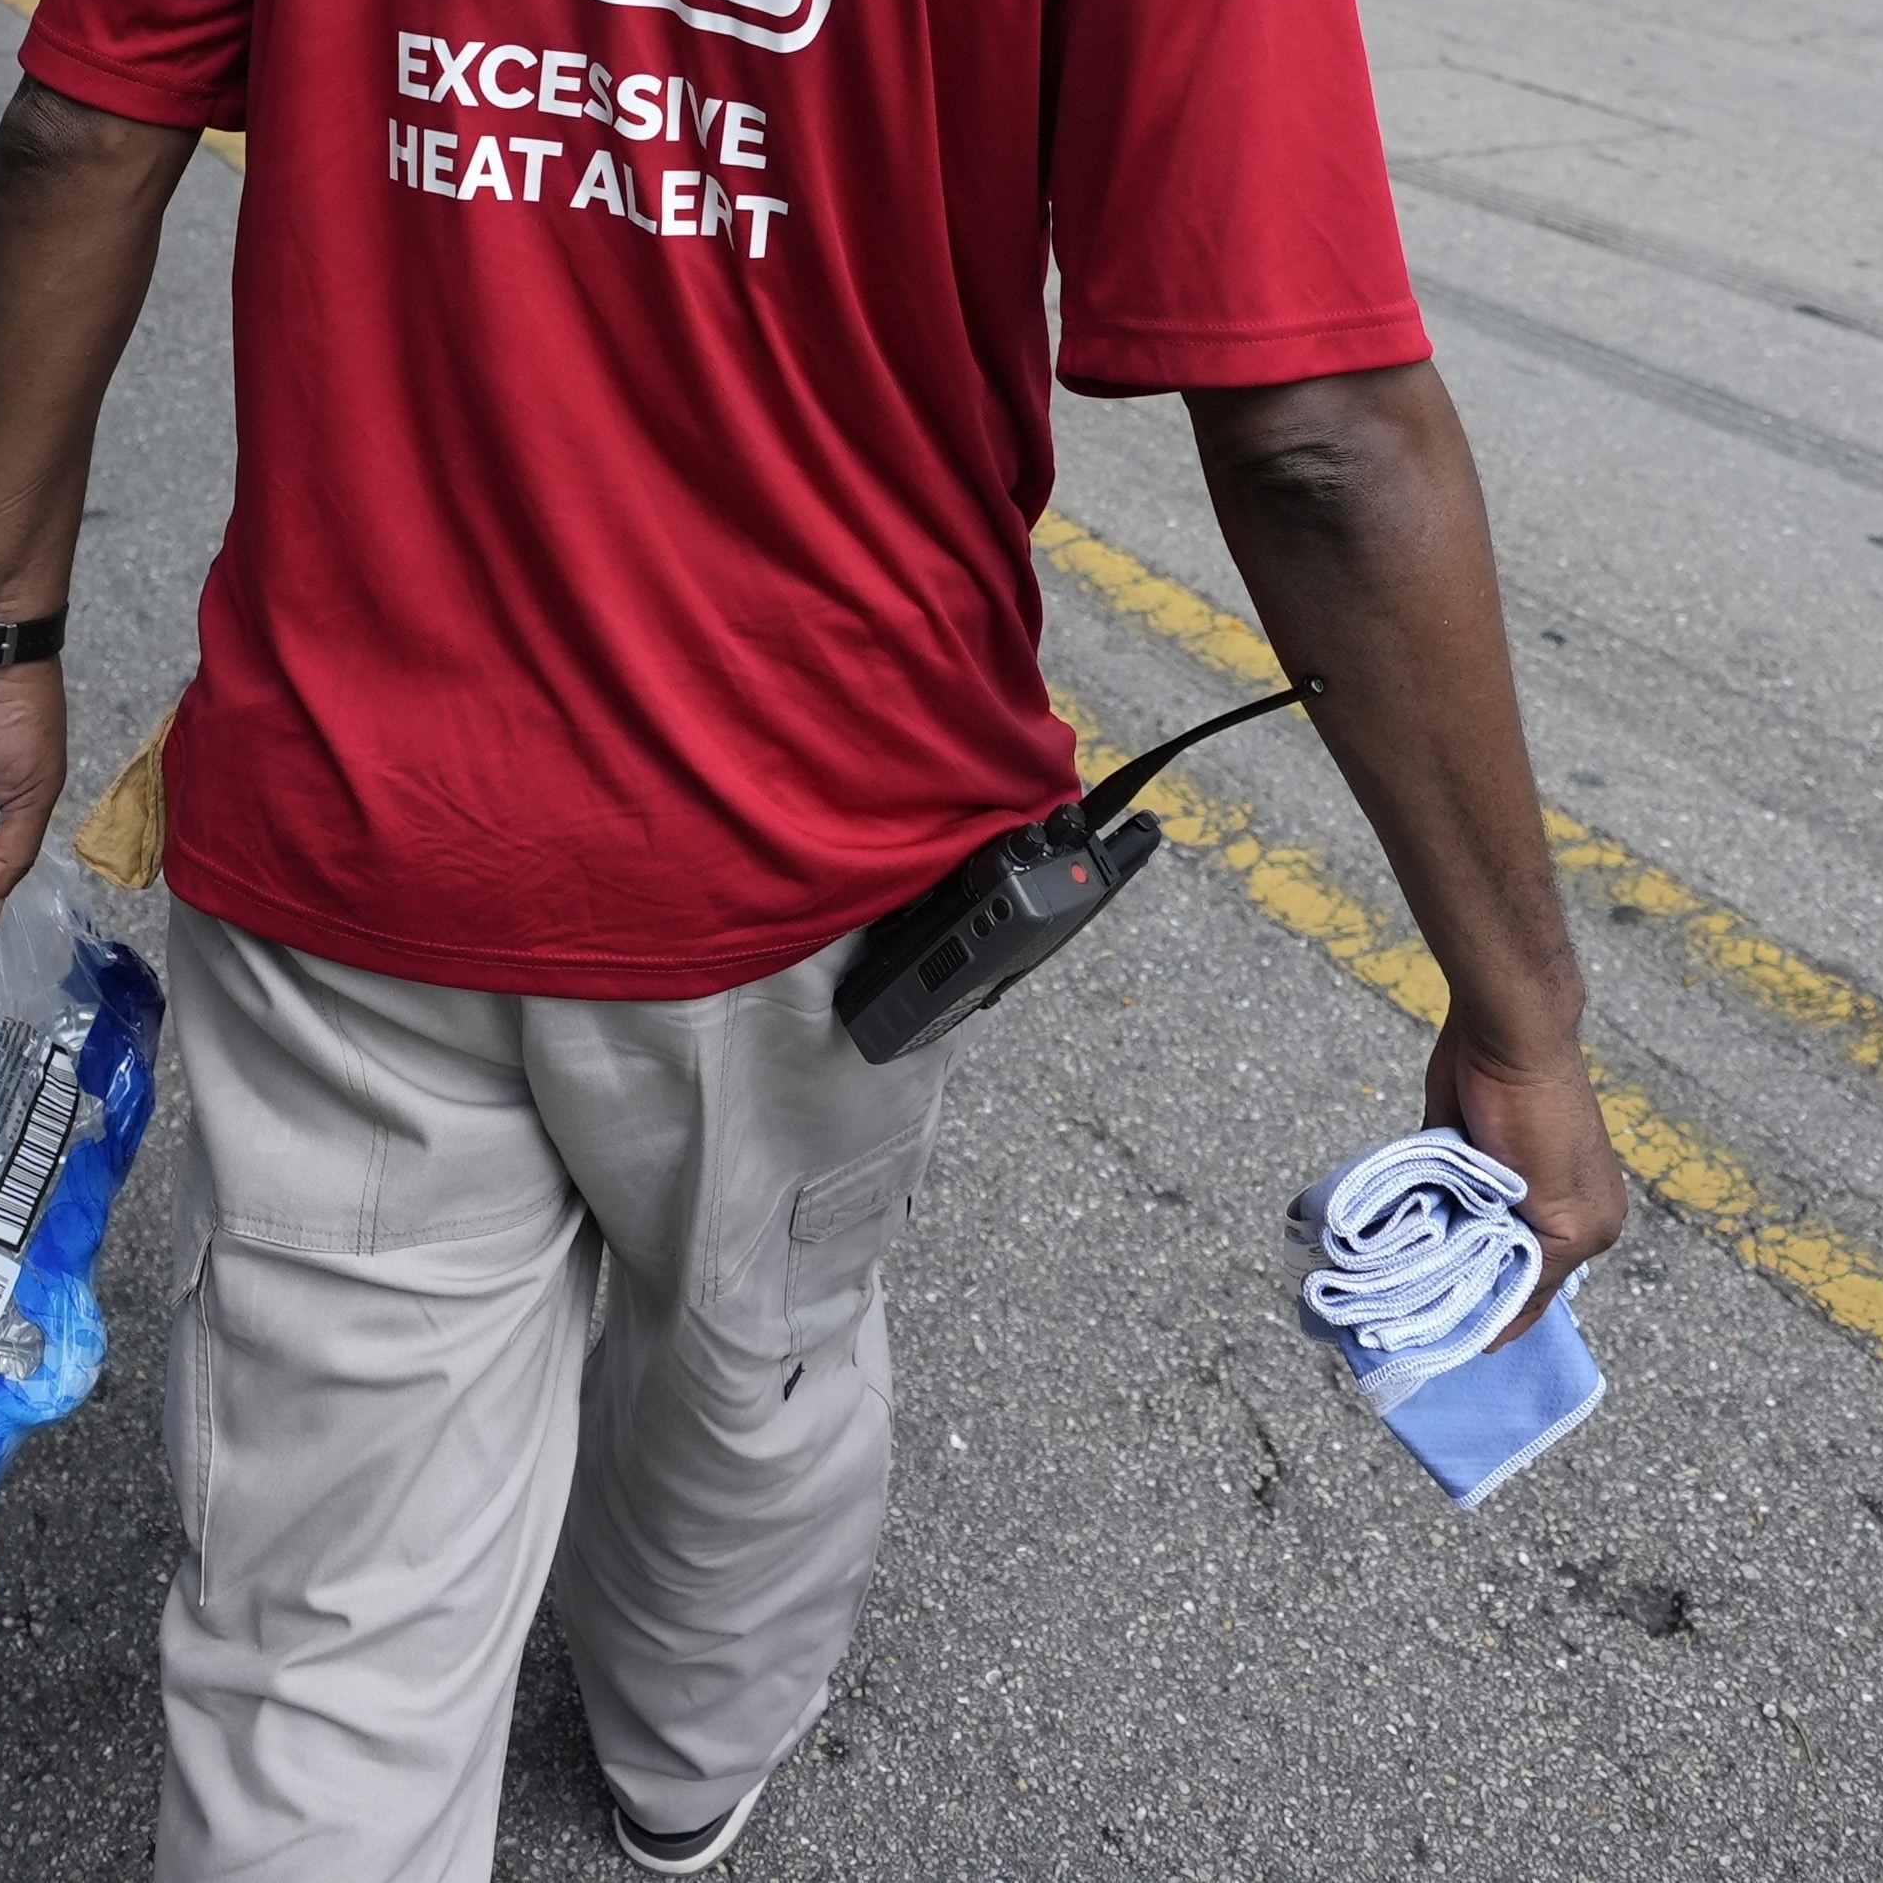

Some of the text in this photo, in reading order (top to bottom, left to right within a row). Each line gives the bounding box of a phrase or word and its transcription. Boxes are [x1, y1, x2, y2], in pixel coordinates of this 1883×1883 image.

[397, 30, 768, 170] EXCESSIVE
[388, 118, 789, 259] HEAT ALERT
